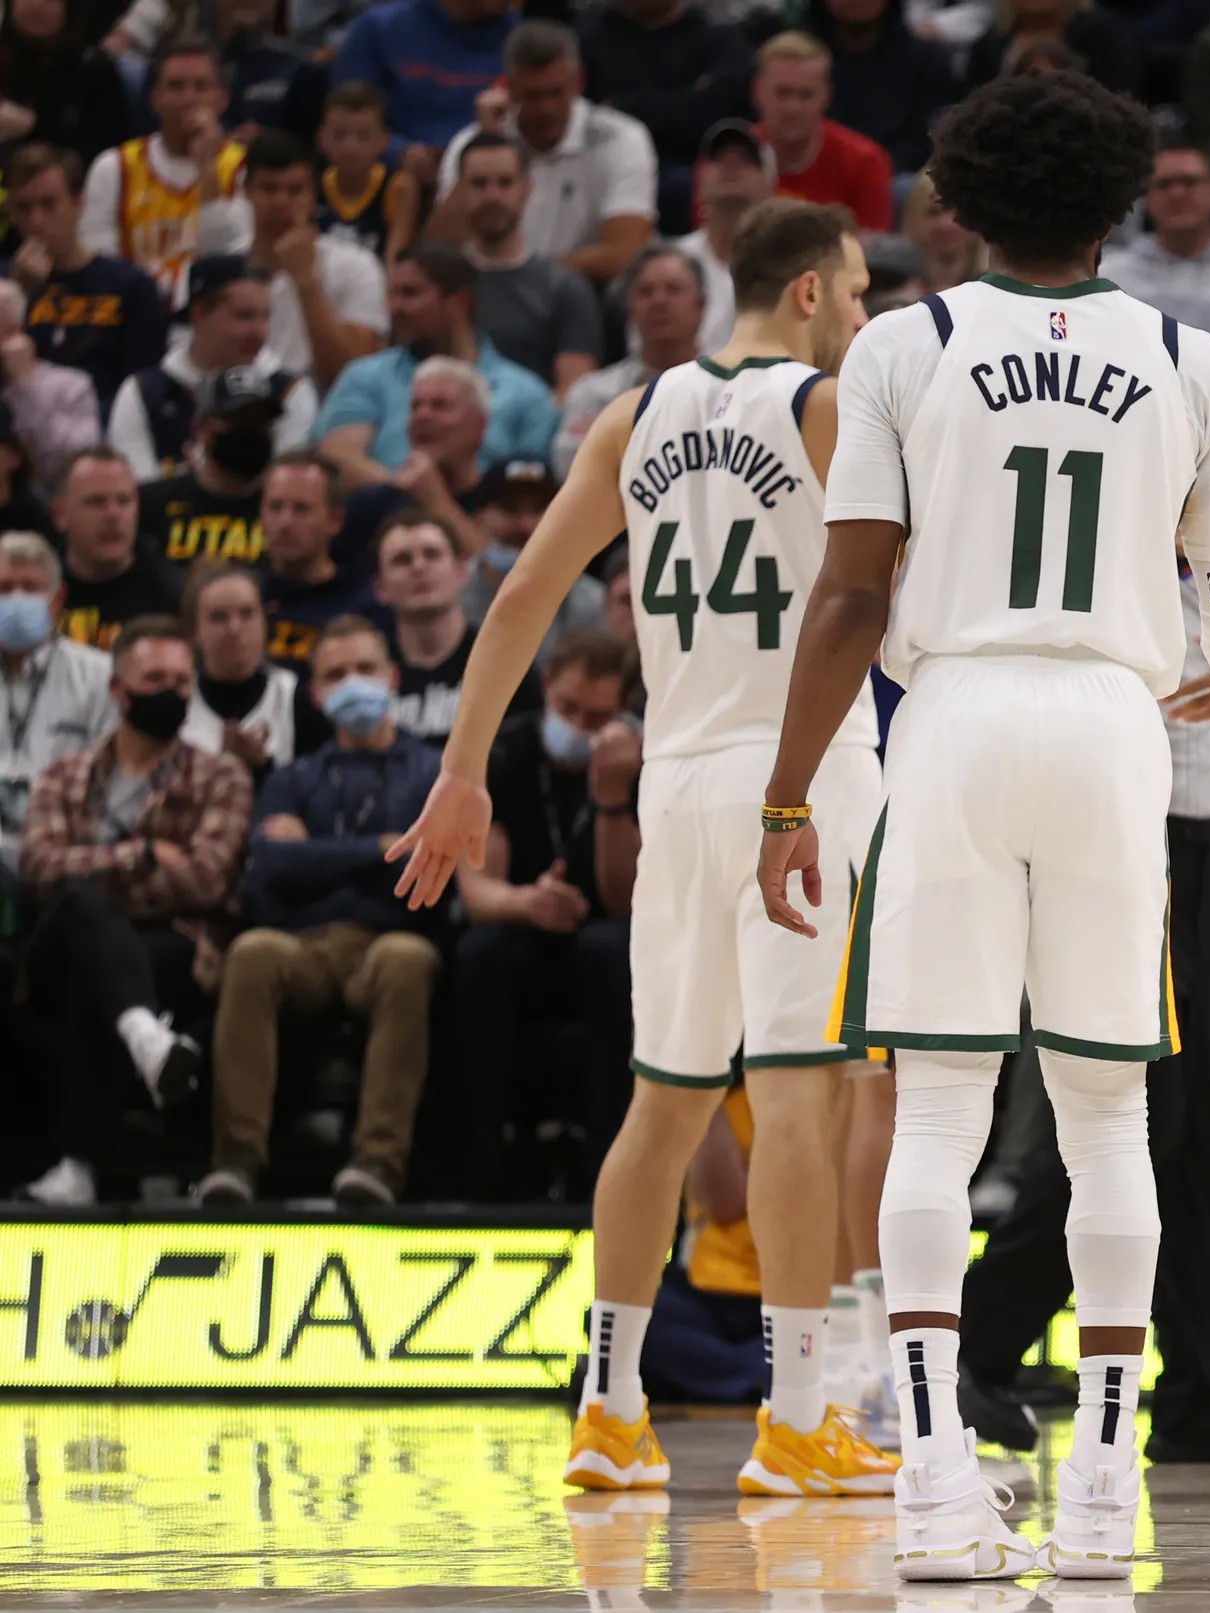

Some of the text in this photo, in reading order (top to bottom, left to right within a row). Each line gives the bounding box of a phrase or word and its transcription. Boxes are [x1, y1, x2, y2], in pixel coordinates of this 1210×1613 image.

[970, 351, 1152, 424] CONLEY
[629, 427, 804, 514] BOGDANOVIĆ
[1003, 445, 1104, 613] 11
[642, 518, 794, 652] 44
[208, 1250, 573, 1361] JAZZ
